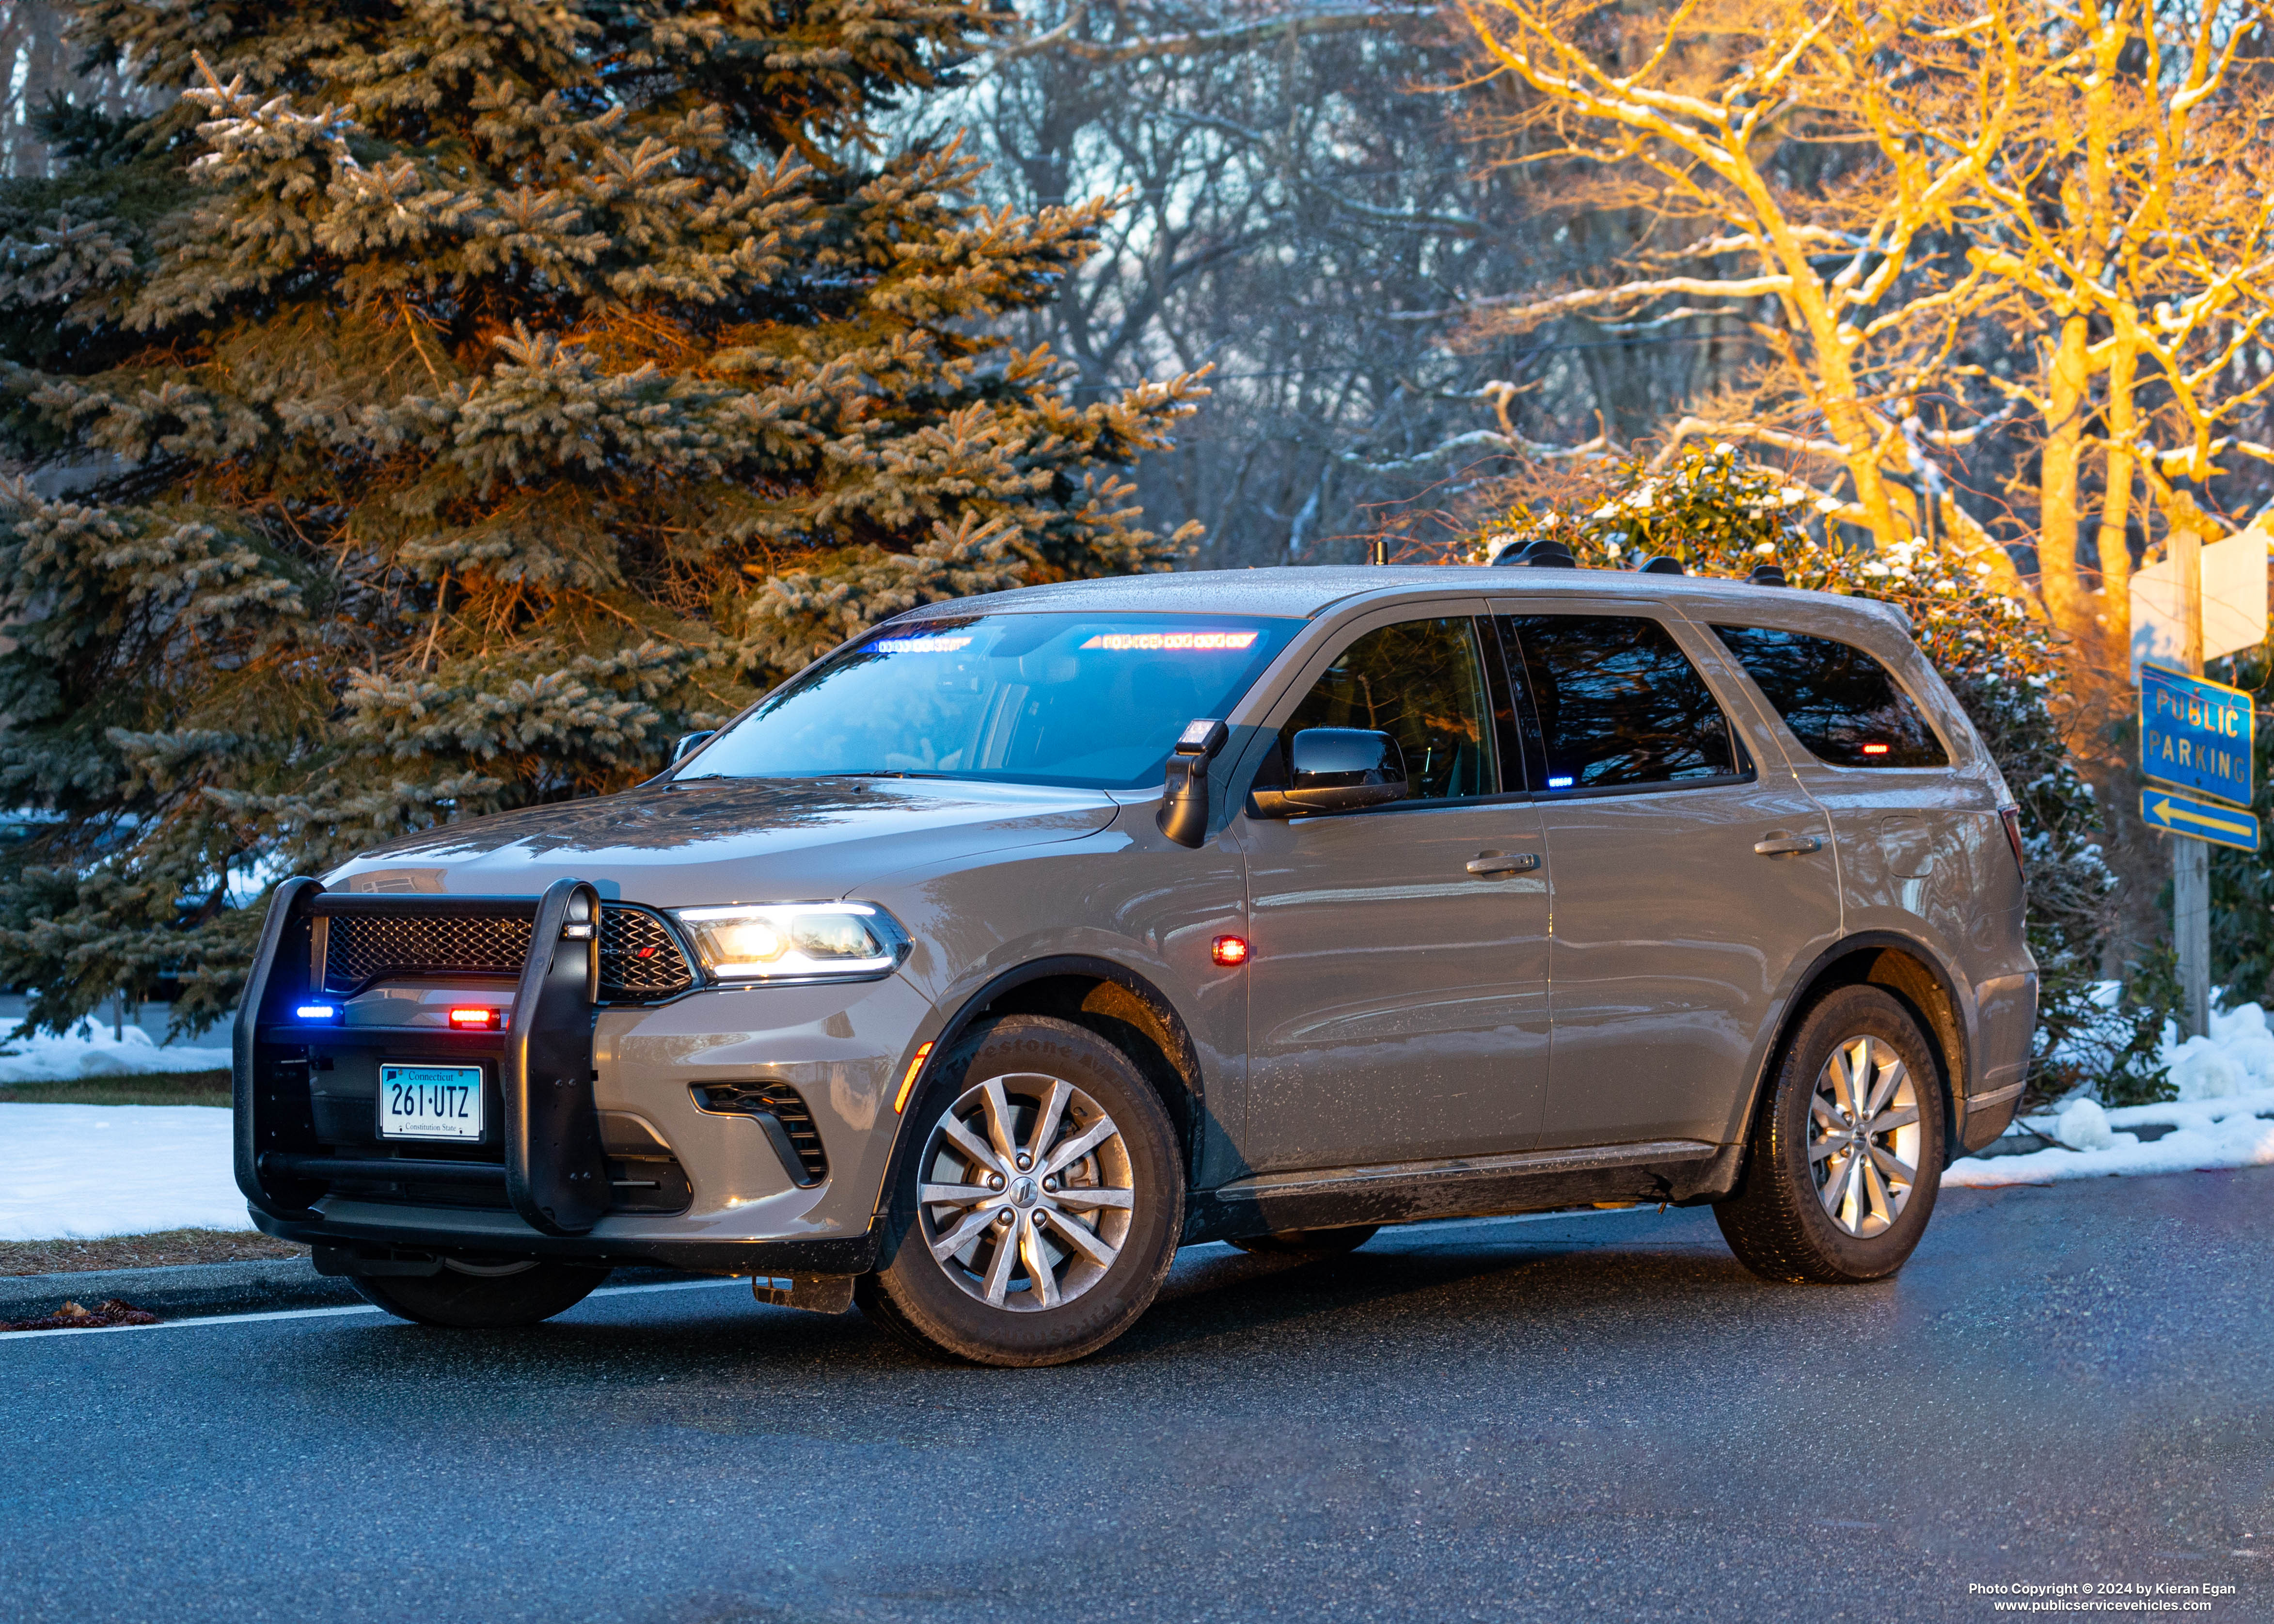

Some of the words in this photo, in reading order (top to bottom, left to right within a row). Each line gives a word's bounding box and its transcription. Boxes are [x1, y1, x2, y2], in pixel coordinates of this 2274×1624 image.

[2157, 688, 2239, 738] PUBLIC
[2148, 729, 2245, 783] PARKING
[409, 1071, 454, 1081] Connecticut
[405, 1122, 441, 1131] Constitution
